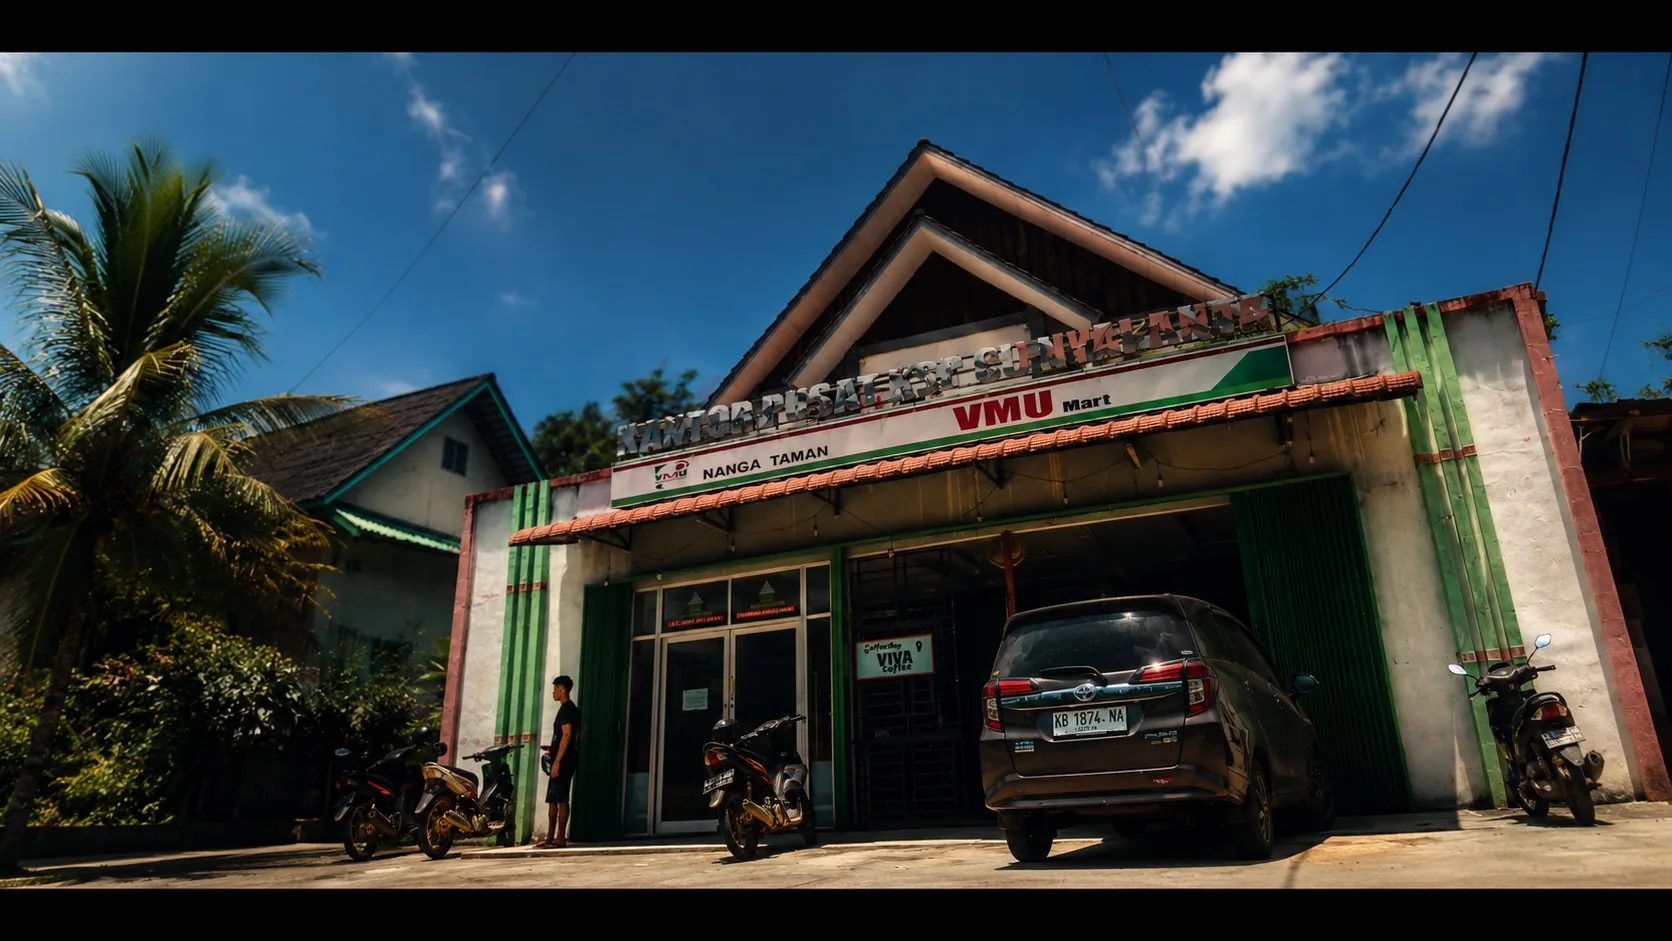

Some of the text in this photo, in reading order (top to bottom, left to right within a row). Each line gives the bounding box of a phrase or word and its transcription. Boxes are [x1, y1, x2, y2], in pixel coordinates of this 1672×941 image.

[952, 389, 1111, 431] VMU Mart
[617, 399, 753, 457] KANTOR
[703, 446, 828, 480] NANGA TAMAN
[877, 650, 913, 667] VIVA
[1055, 714, 1069, 729] KB
[1109, 709, 1124, 723] NA
